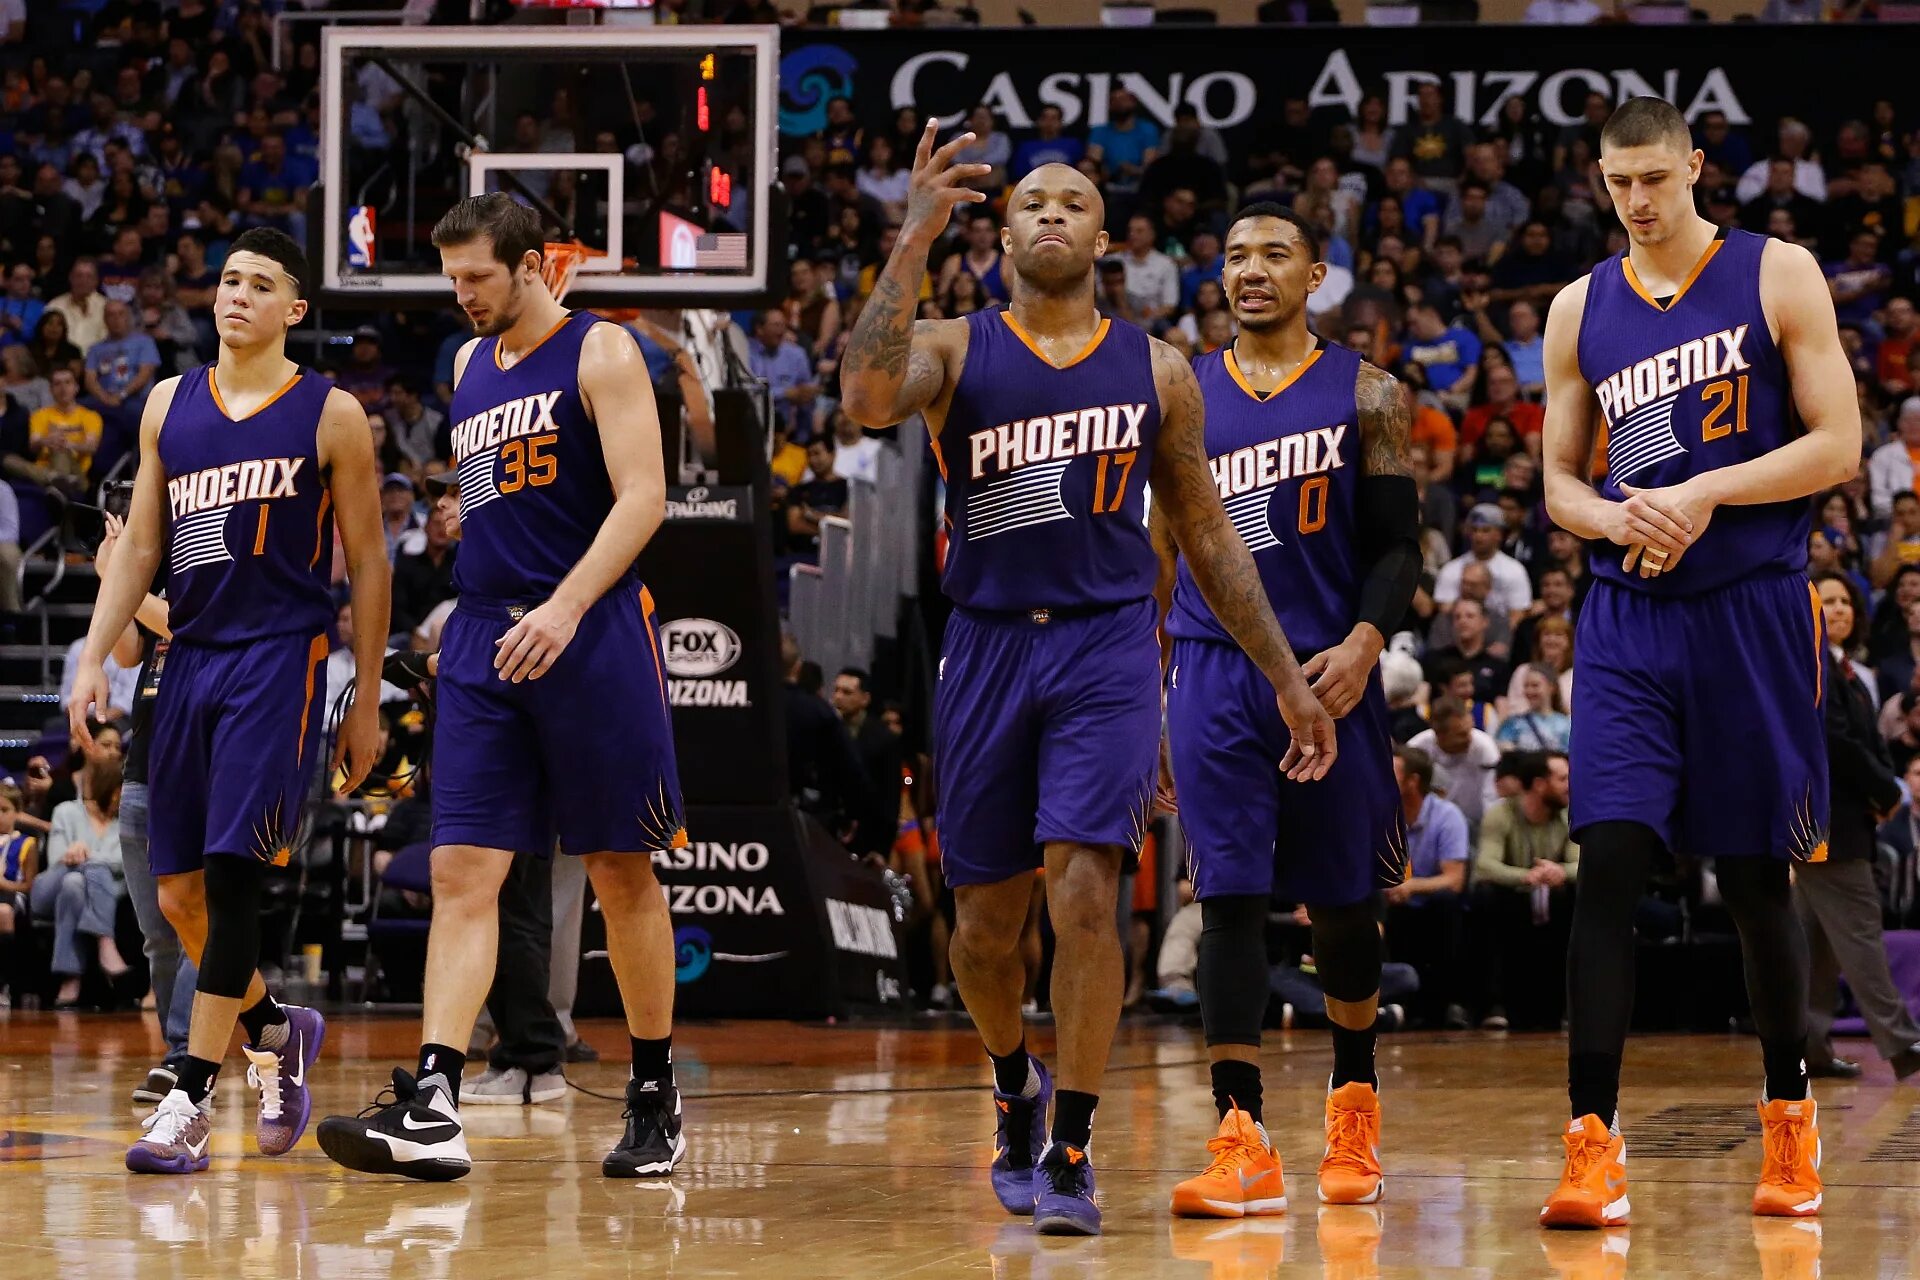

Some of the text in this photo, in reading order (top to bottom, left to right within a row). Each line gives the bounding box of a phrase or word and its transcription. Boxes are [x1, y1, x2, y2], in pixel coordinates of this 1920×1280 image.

[1596, 323, 1751, 429] PHOENIX
[451, 390, 564, 464] PHOENIX
[1701, 374, 1749, 443] 21
[499, 433, 558, 494] 35
[968, 403, 1147, 480] PHOENIX
[1208, 424, 1348, 499] HOENIX
[168, 457, 306, 522] PHOENIX
[1093, 450, 1137, 514] 17
[1298, 475, 1330, 535] 0
[669, 631, 718, 652] FOX
[668, 679, 748, 707] IZONA
[650, 842, 770, 872] ASINO
